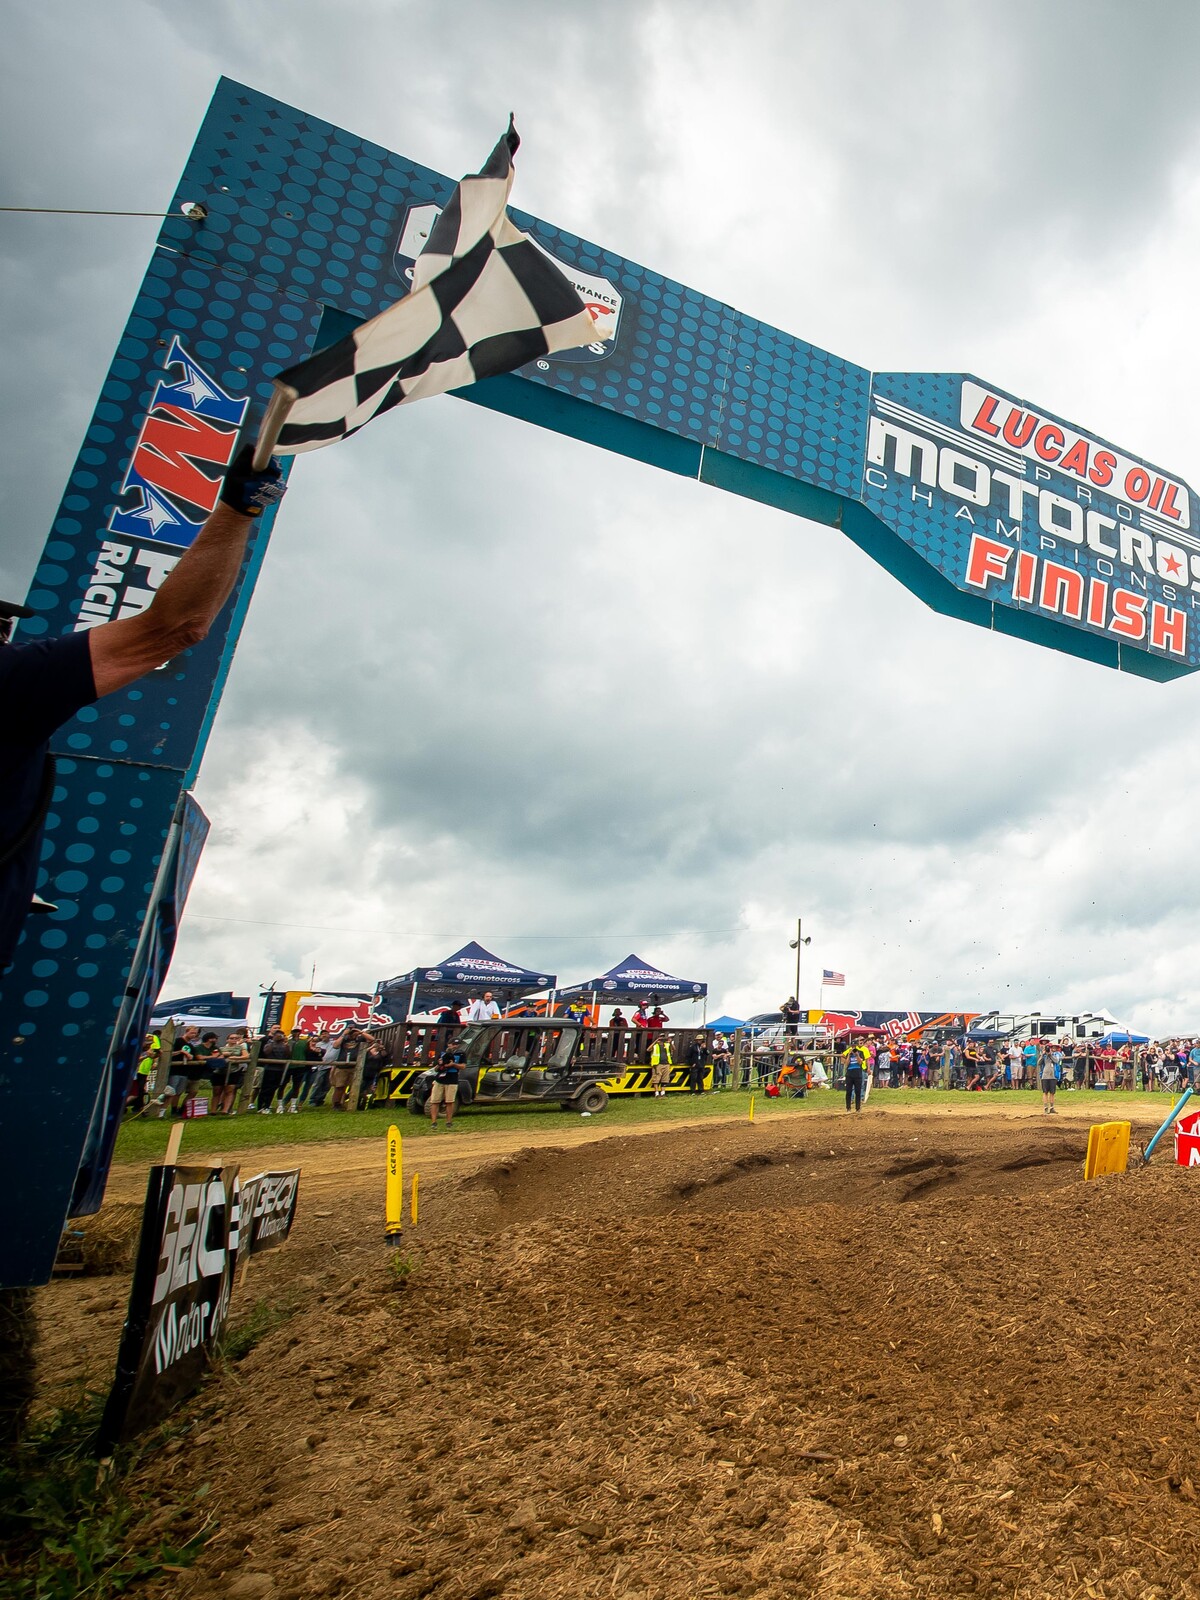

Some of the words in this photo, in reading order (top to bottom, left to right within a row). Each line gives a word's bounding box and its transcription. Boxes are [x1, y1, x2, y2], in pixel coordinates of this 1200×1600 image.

[107, 334, 249, 549] AMA
[971, 394, 1118, 488] LUCAS
[1124, 467, 1182, 521] OIL
[1035, 466, 1133, 521] PRO
[73, 541, 133, 633] RACIN
[964, 532, 1188, 657] FINISH
[456, 972, 521, 983] @promotocross
[628, 981, 680, 990] @promotocross
[889, 1011, 922, 1040] Bull
[151, 1181, 226, 1305] GEIC
